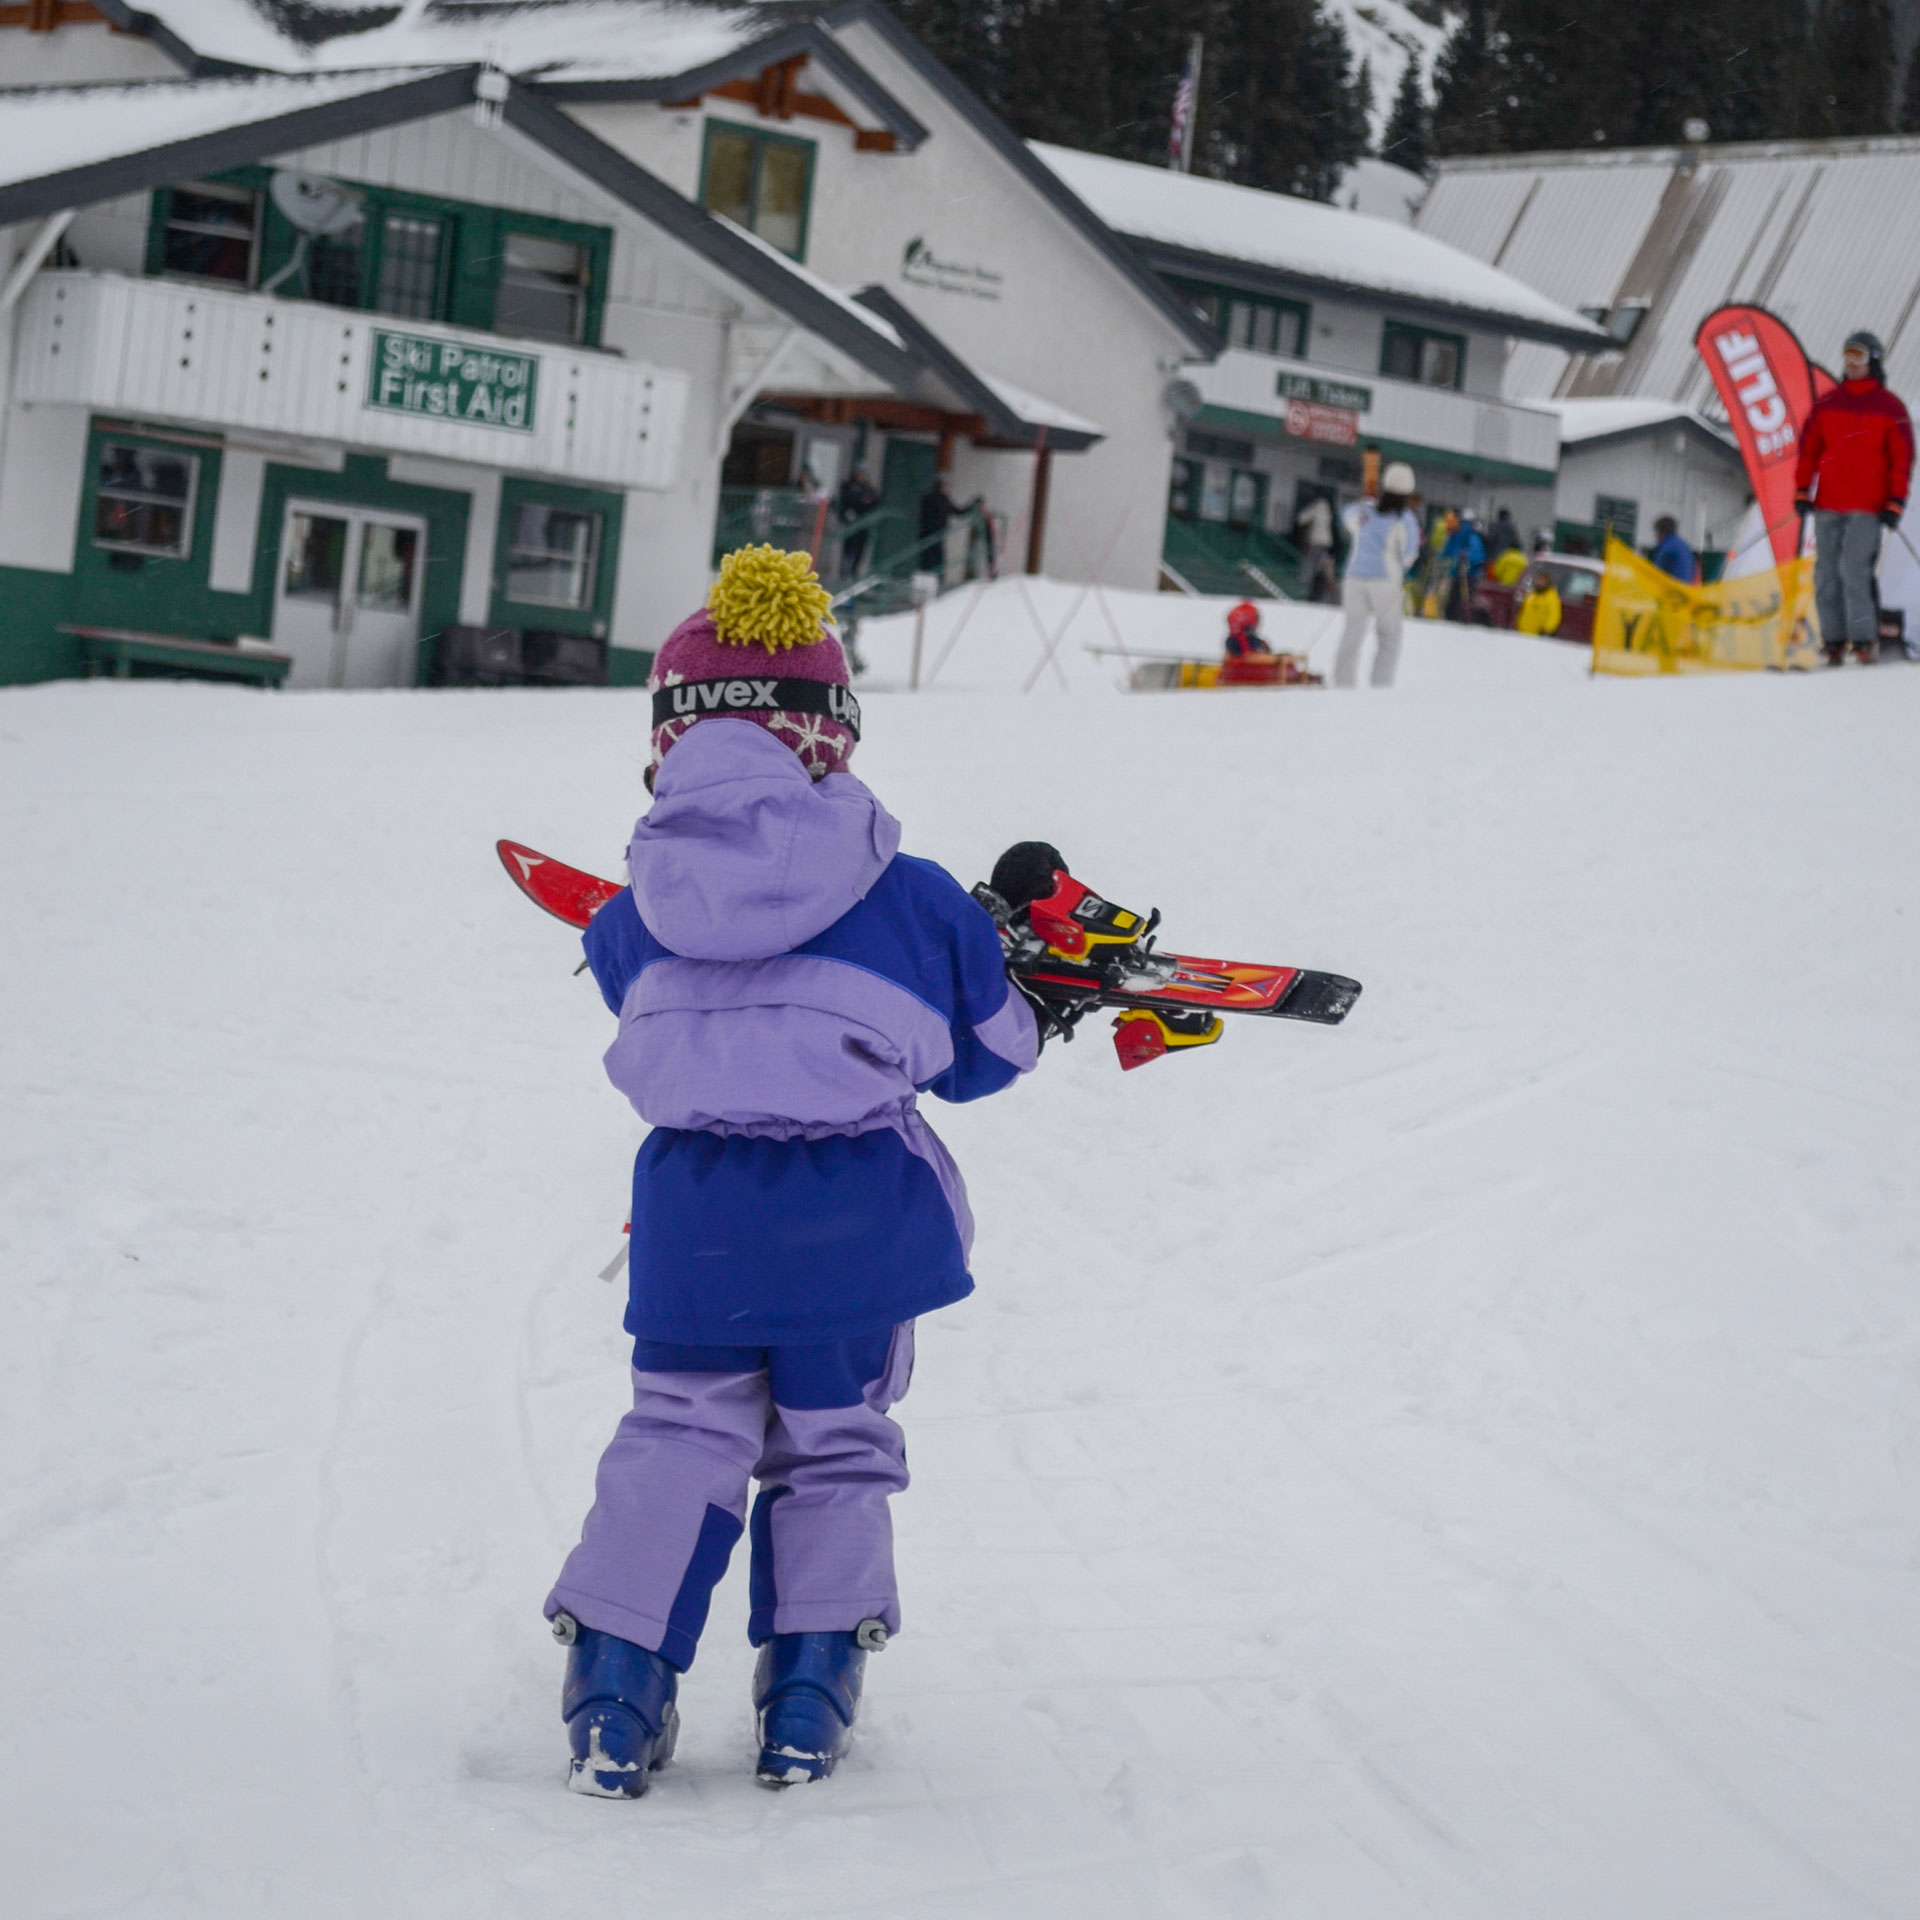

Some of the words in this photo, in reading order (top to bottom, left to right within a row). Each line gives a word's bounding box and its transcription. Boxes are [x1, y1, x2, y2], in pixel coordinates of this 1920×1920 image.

[383, 337, 432, 372] Ski
[440, 343, 530, 388] Patrol
[1714, 330, 1787, 433] CLIF
[380, 369, 460, 415] First
[466, 382, 527, 427] Aid
[673, 680, 780, 714] uvex
